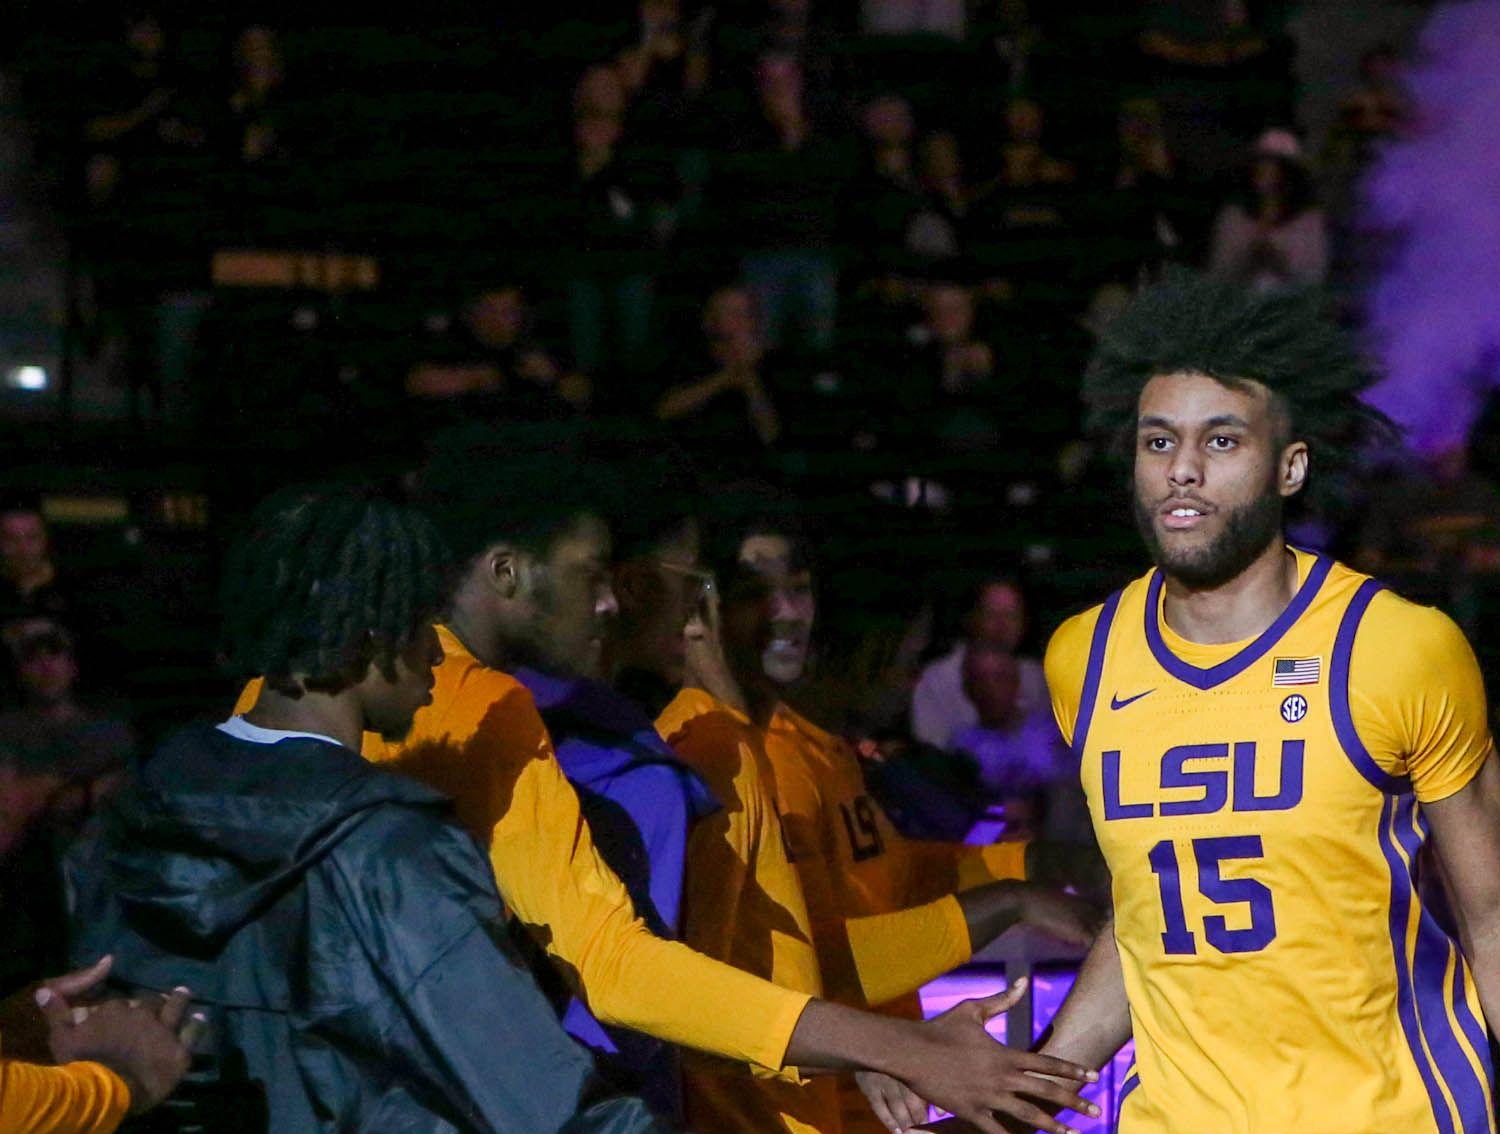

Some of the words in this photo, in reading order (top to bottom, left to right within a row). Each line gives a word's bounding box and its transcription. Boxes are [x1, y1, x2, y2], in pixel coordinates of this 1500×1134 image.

[1282, 694, 1307, 721] SEC
[1102, 739, 1305, 821] LSU
[839, 796, 885, 862] LS
[1148, 835, 1277, 955] 15
